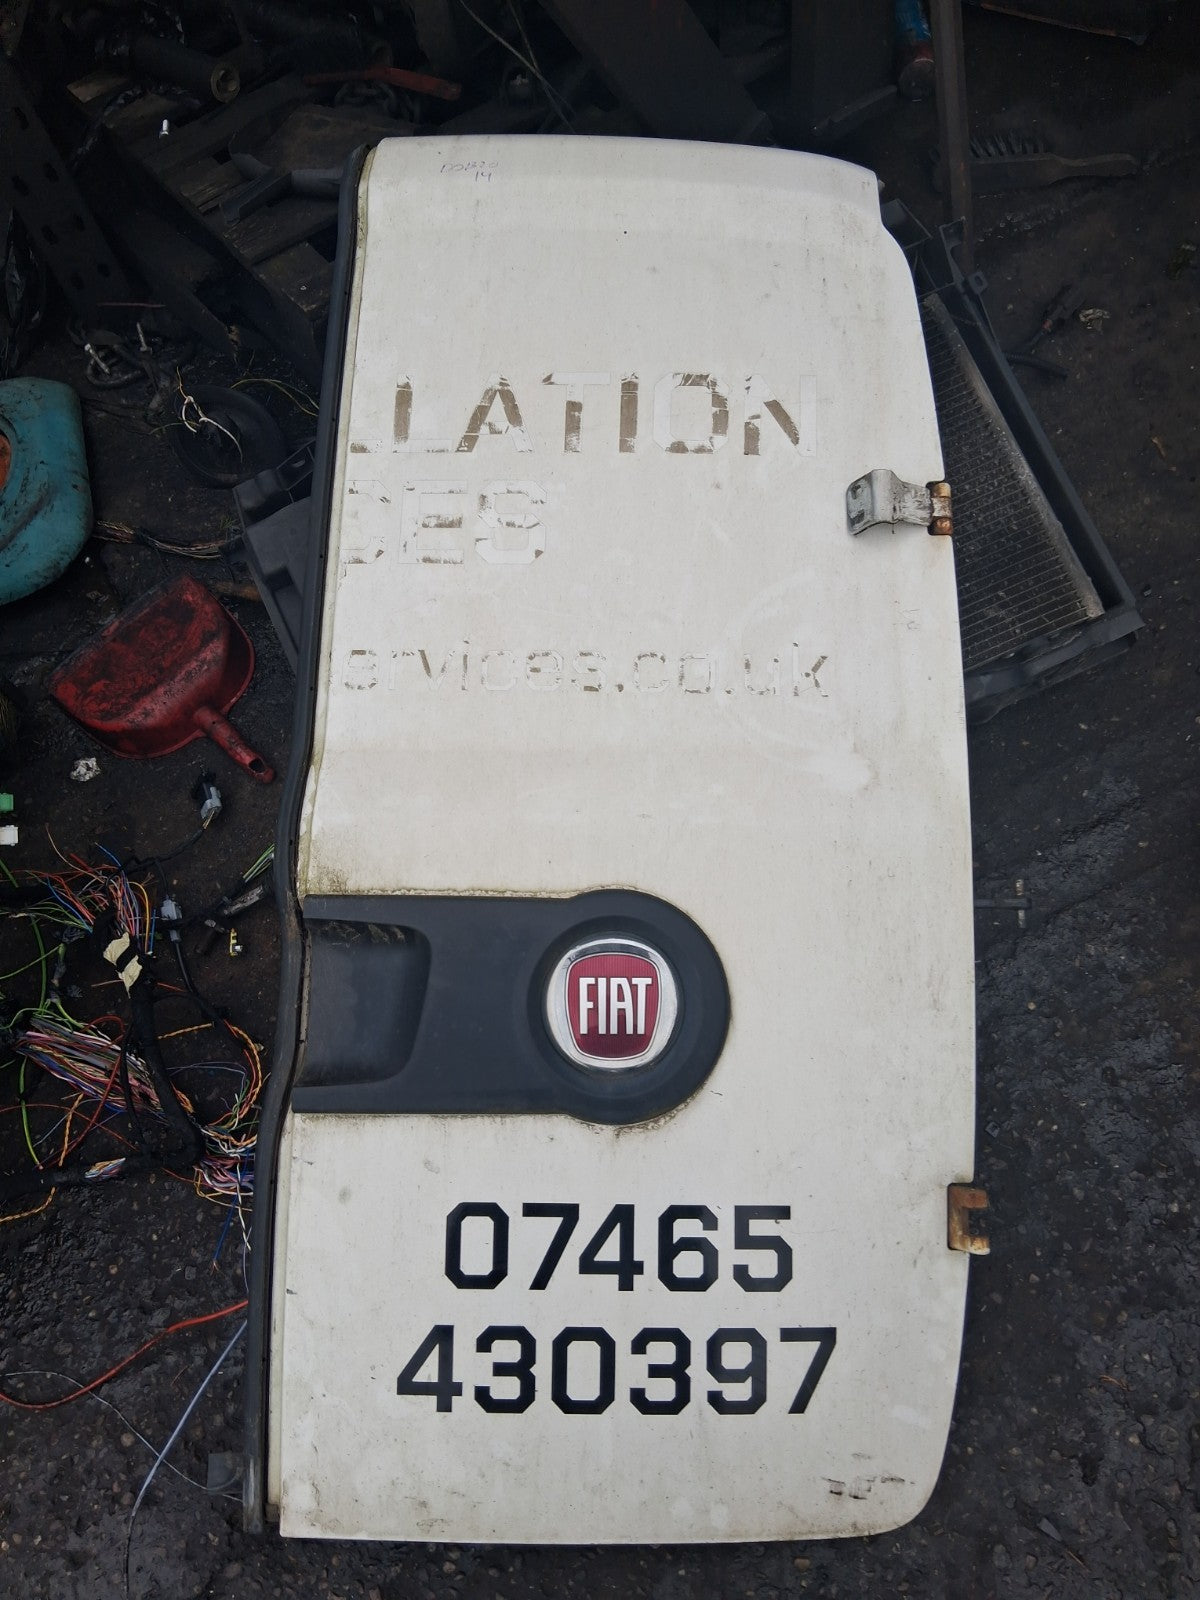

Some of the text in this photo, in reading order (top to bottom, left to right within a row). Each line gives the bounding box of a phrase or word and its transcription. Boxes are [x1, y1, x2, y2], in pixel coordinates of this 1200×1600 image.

[578, 976, 653, 1035] FIAT
[444, 1201, 793, 1293] 07465
[396, 1324, 838, 1416] 430397
